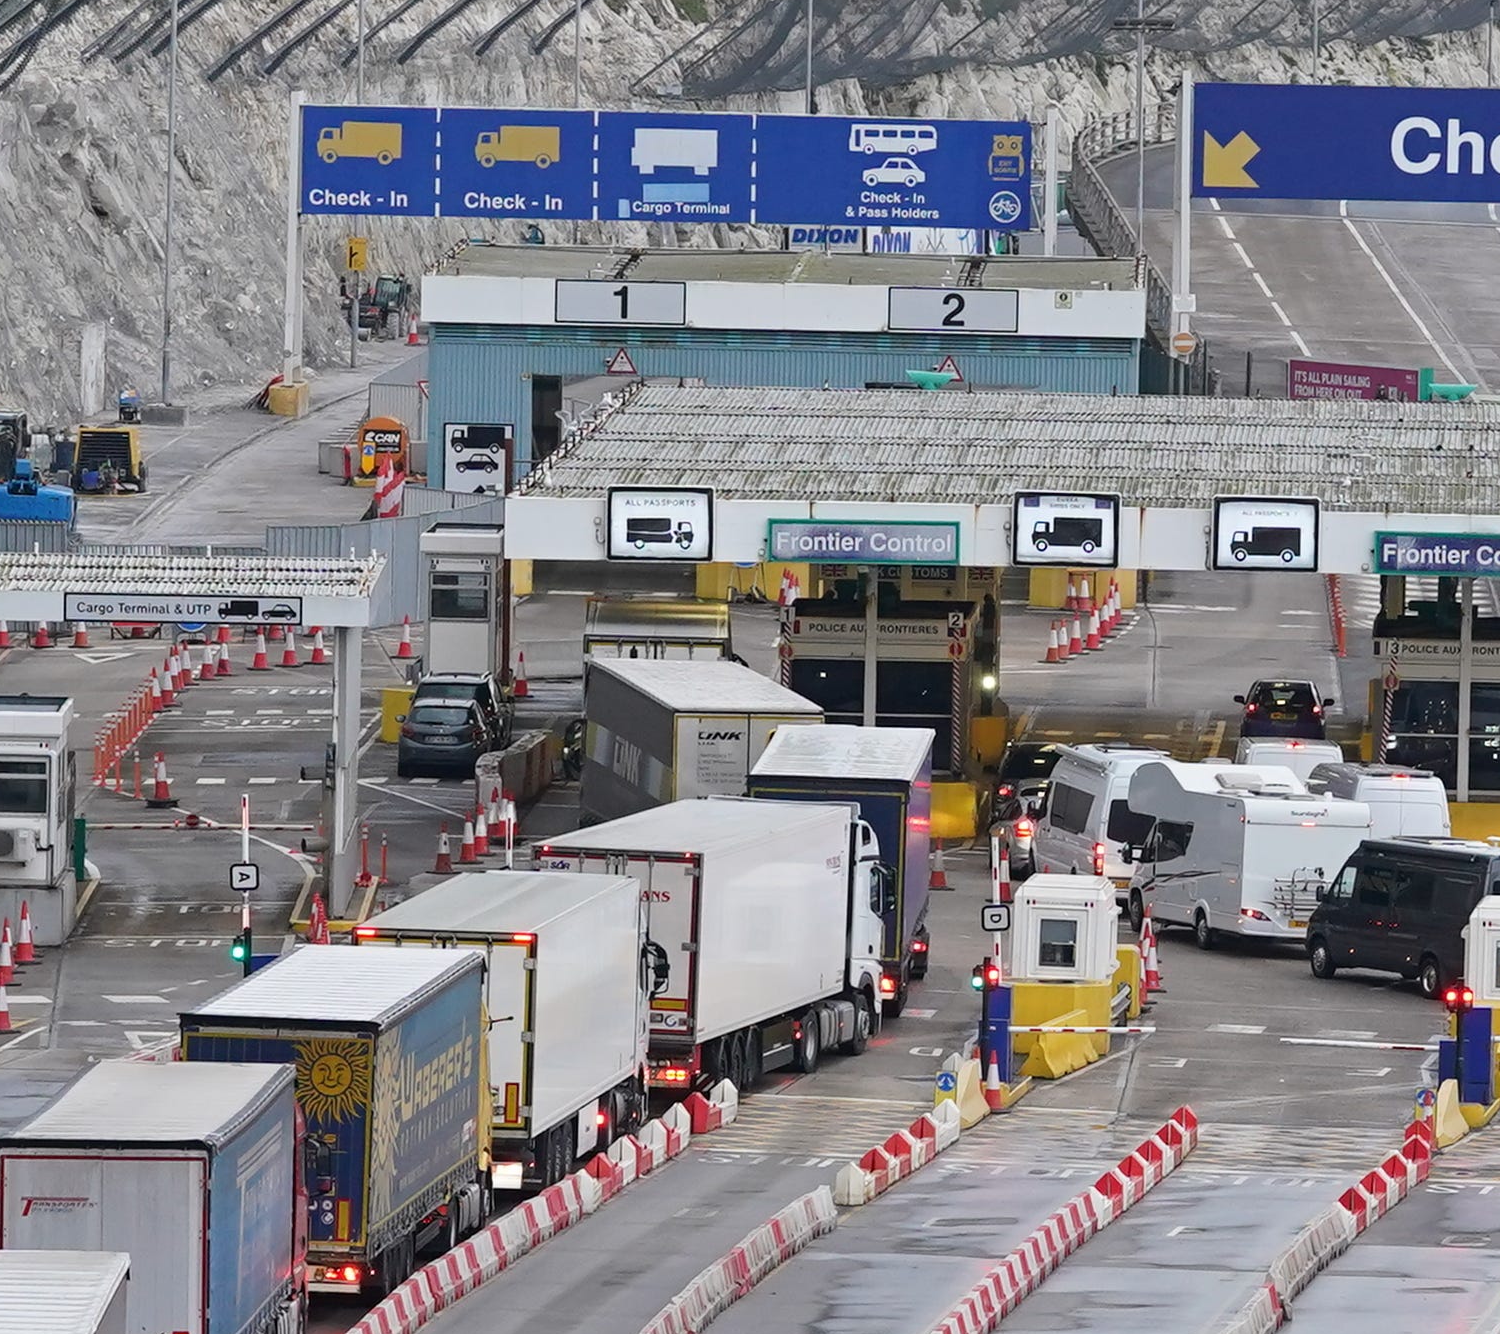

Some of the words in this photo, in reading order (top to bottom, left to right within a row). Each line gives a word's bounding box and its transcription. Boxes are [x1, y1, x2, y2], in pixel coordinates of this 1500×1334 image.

[309, 188, 371, 208] Check
[390, 189, 409, 208] In
[463, 191, 526, 211] Check
[545, 192, 563, 211] In
[860, 191, 902, 204] Check
[913, 193, 925, 205] In
[632, 201, 671, 215] Cargo
[674, 202, 730, 215] Terminal
[846, 206, 855, 218] &
[858, 207, 888, 219] Pass
[891, 208, 940, 220] Holders
[791, 228, 859, 244] DIXON
[613, 287, 629, 319] 1
[942, 294, 966, 327] 2
[1308, 372, 1321, 383] ALL
[1322, 373, 1343, 385] PLAIN
[1344, 374, 1371, 388] SAILING
[1293, 384, 1312, 397] FROM
[1313, 385, 1329, 398] HERE
[1330, 387, 1340, 398] ON
[625, 499, 642, 507] ALL
[644, 499, 696, 508] PASSPORTS
[776, 533, 862, 553] Frontier
[869, 534, 952, 554] Control
[1382, 543, 1470, 564] Frontier
[887, 566, 949, 578] CUTOMS
[76, 601, 114, 615] Cargo
[118, 602, 171, 615] Terminal
[173, 604, 182, 615] &
[186, 605, 212, 616] UTP
[950, 612, 962, 627] 2
[807, 623, 845, 635] POLICE
[848, 624, 866, 636] AU
[876, 624, 939, 635] RONTIERES
[1389, 641, 1400, 655] 3
[1401, 644, 1438, 655] POLICE
[1441, 645, 1462, 656] AUX
[239, 871, 251, 883] A
[990, 913, 1002, 924] D
[944, 1163, 1100, 1178] STOP
